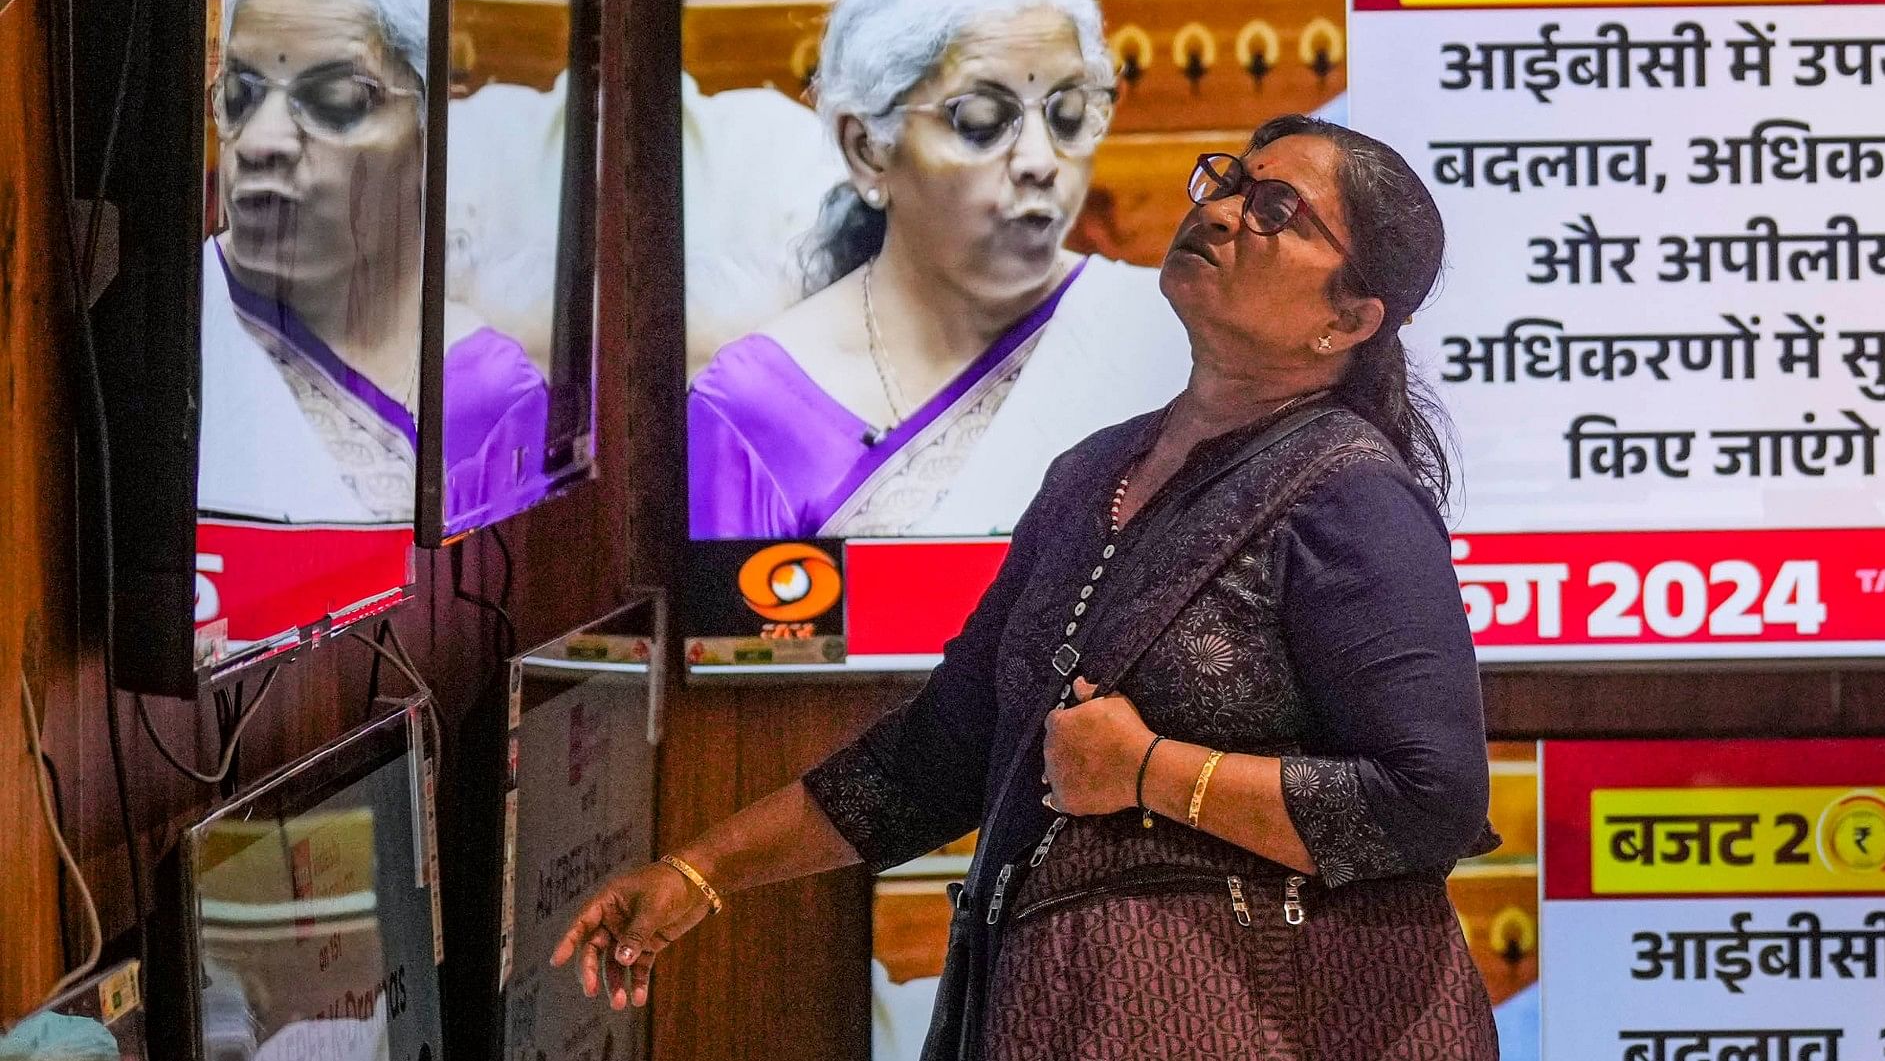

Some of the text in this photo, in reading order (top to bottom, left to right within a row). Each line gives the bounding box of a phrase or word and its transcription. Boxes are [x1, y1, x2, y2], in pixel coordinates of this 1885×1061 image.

[1440, 21, 1712, 104] आईबीसी
[1725, 21, 1777, 87] में
[1428, 139, 1667, 194] बदलाव,
[1527, 214, 1641, 285] और
[1441, 314, 1761, 383] अधिकरणों
[1774, 313, 1825, 379] में
[1563, 410, 1881, 479] किए जाएंगे
[1587, 560, 1827, 638] 2024
[1604, 813, 1760, 867] बजट
